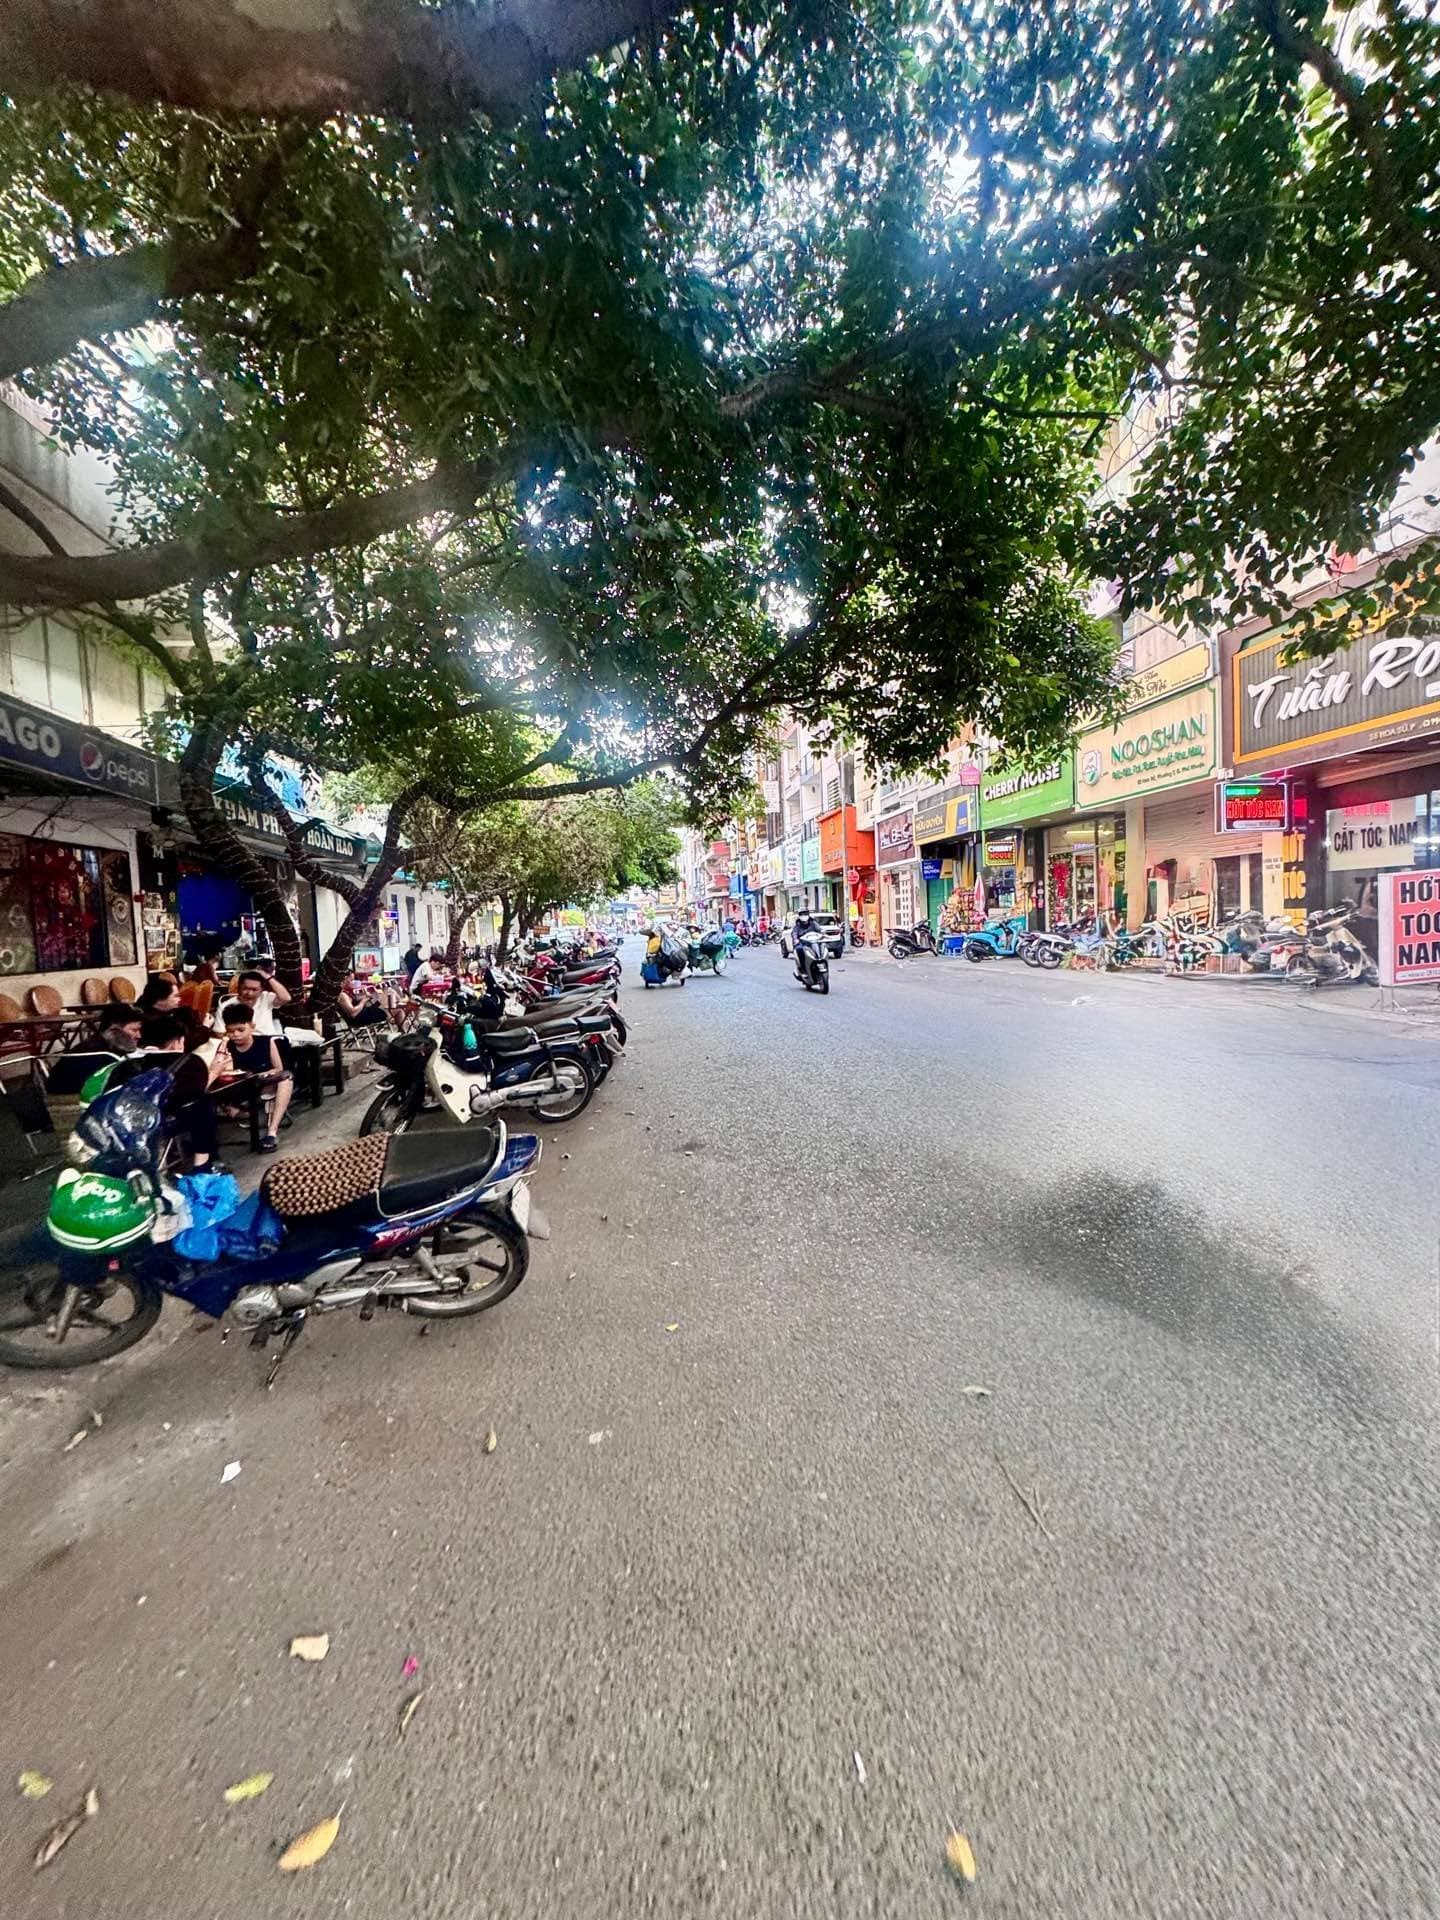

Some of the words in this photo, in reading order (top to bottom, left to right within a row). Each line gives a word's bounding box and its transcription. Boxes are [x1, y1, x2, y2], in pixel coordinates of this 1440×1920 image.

[1111, 712, 1207, 765] NOOSHAN
[107, 760, 150, 788] pepsi
[984, 776, 1020, 801] CHERRY
[1021, 760, 1062, 790] HOUSE
[1361, 821, 1383, 849] TÓC
[1389, 820, 1418, 846] NAM
